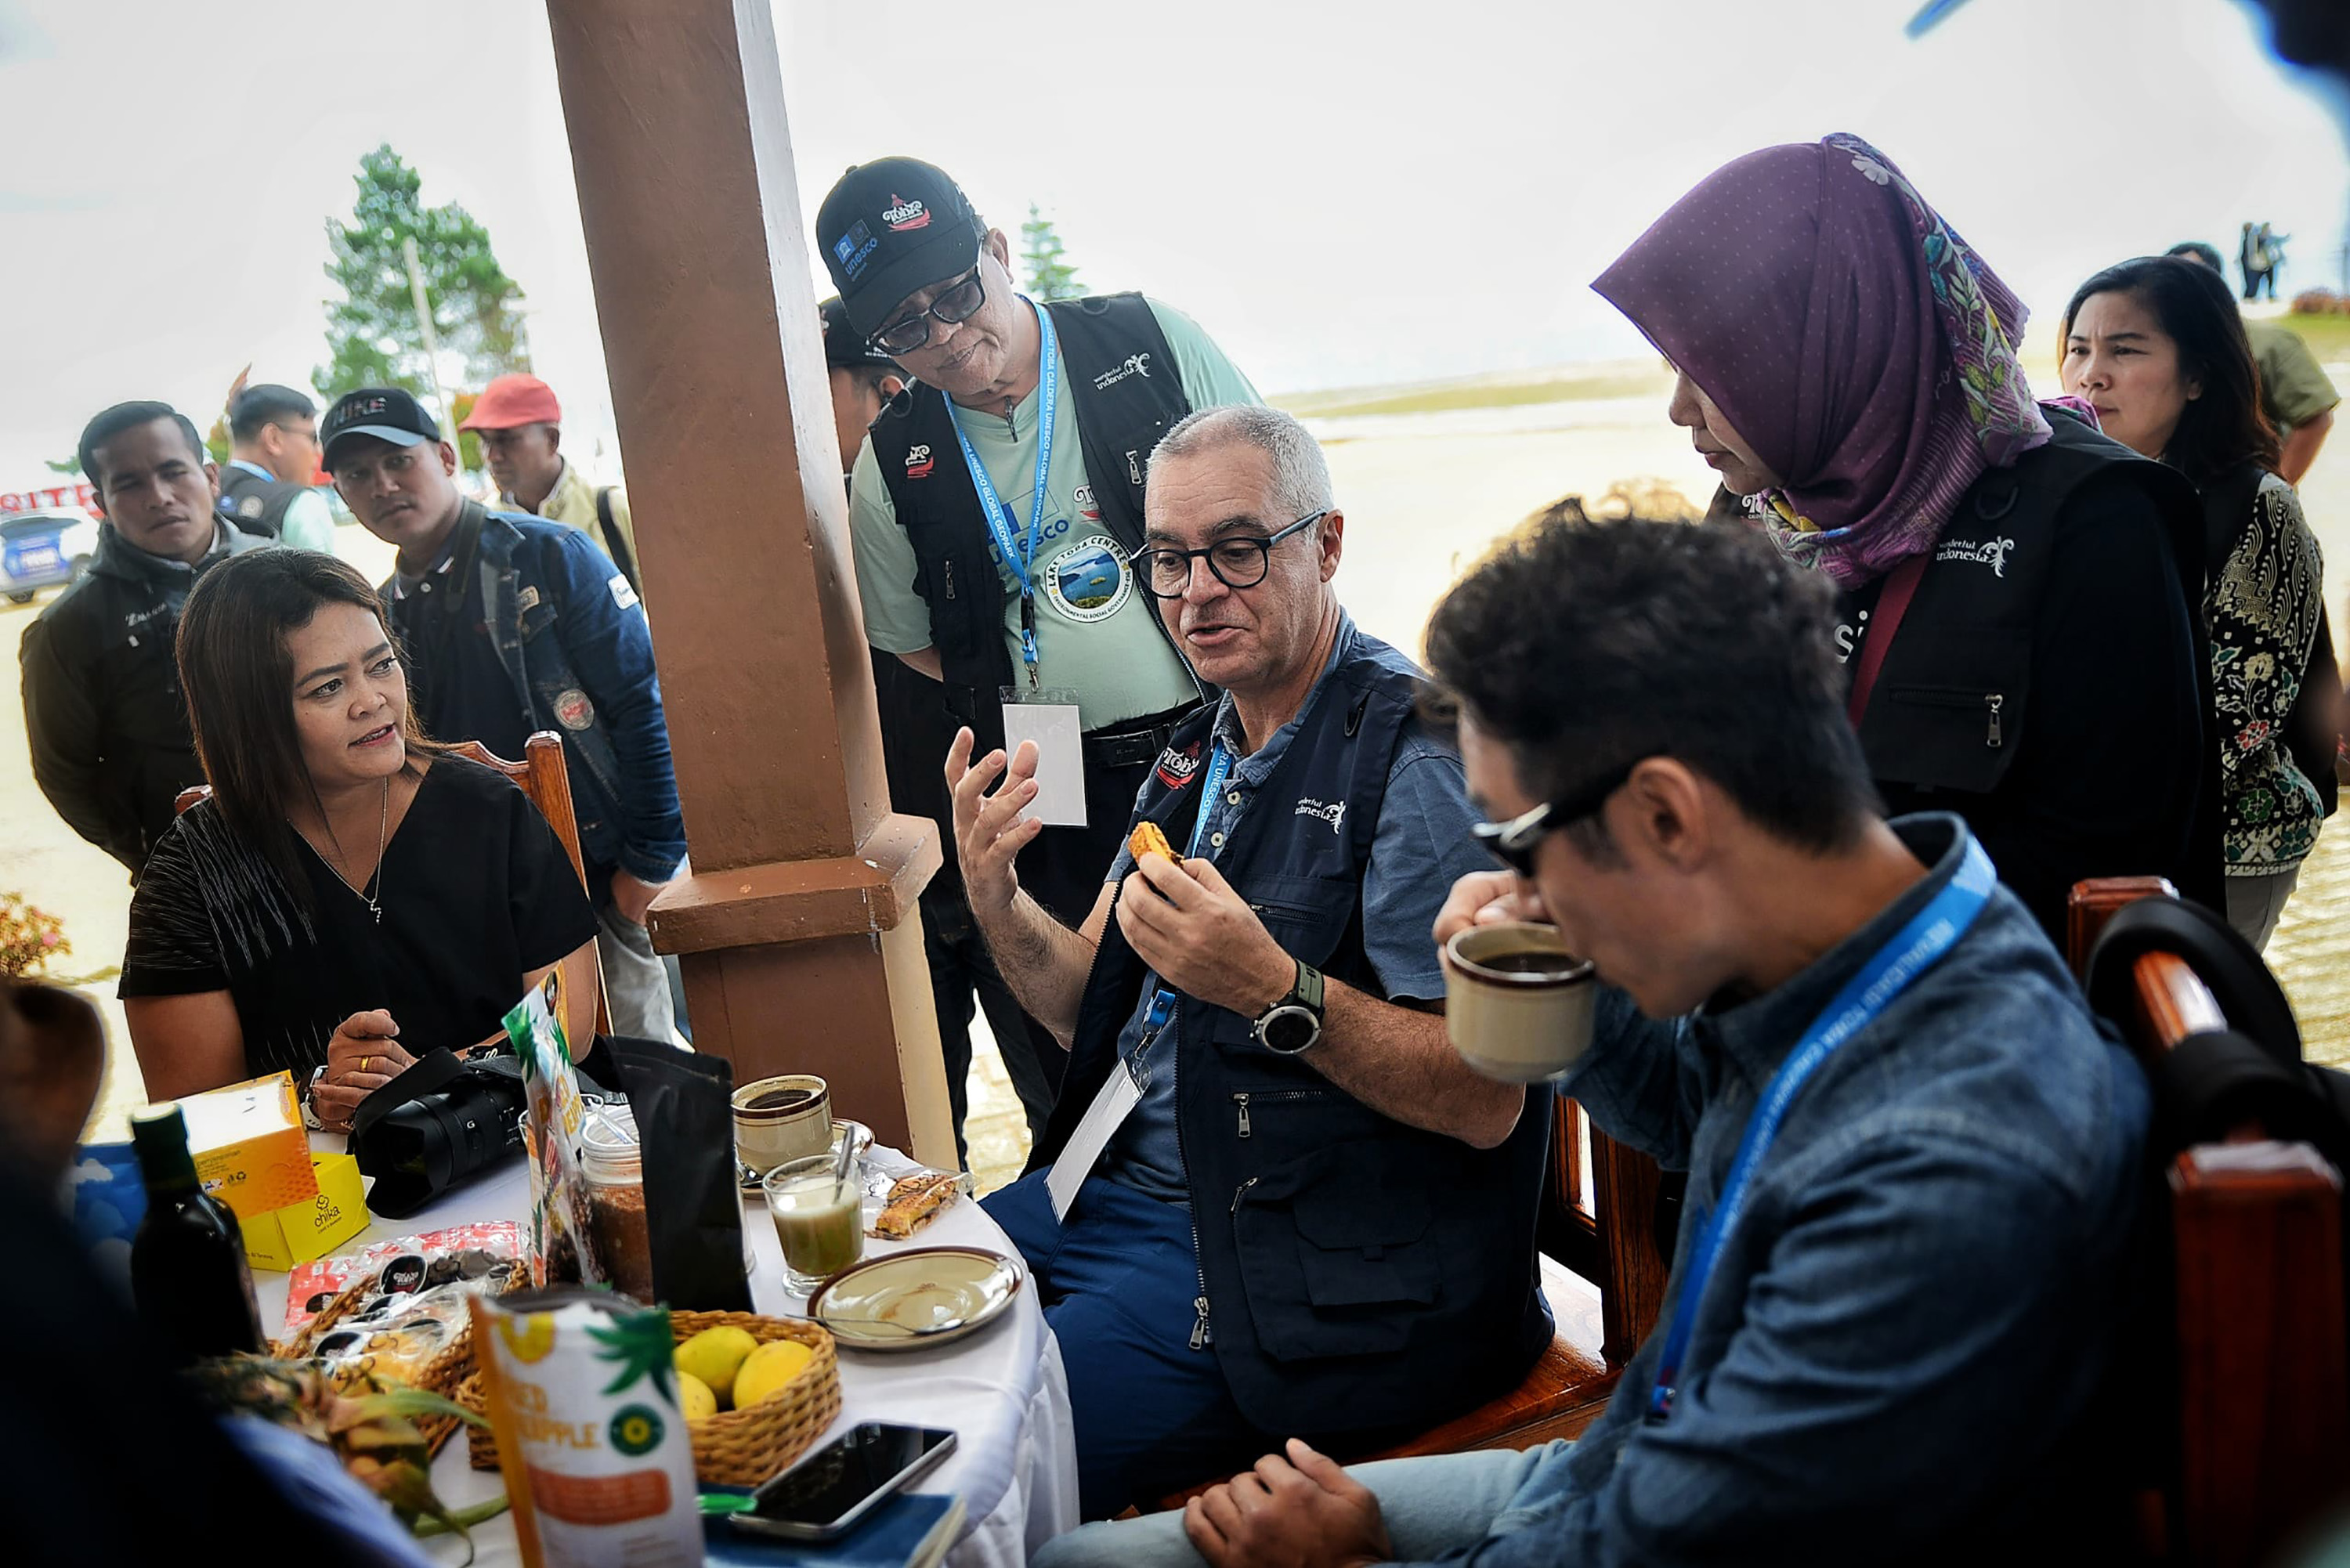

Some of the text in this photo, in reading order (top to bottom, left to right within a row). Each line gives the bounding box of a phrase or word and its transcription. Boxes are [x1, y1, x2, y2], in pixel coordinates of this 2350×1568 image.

[845, 237, 878, 276] unesco
[1045, 370, 1055, 411] CALDERA
[1043, 413, 1054, 449] UNESCO
[1038, 450, 1050, 485] GLOBAL
[969, 453, 988, 487] UNESCO
[982, 485, 1000, 520] GLOBAL
[995, 520, 1016, 558] GEOPARK
[1033, 486, 1045, 528] GEOPARK
[1090, 537, 1130, 563] CENTRE
[1204, 768, 1227, 807] UNESCO
[466, 1120, 475, 1129] G
[314, 1205, 342, 1227] chika
